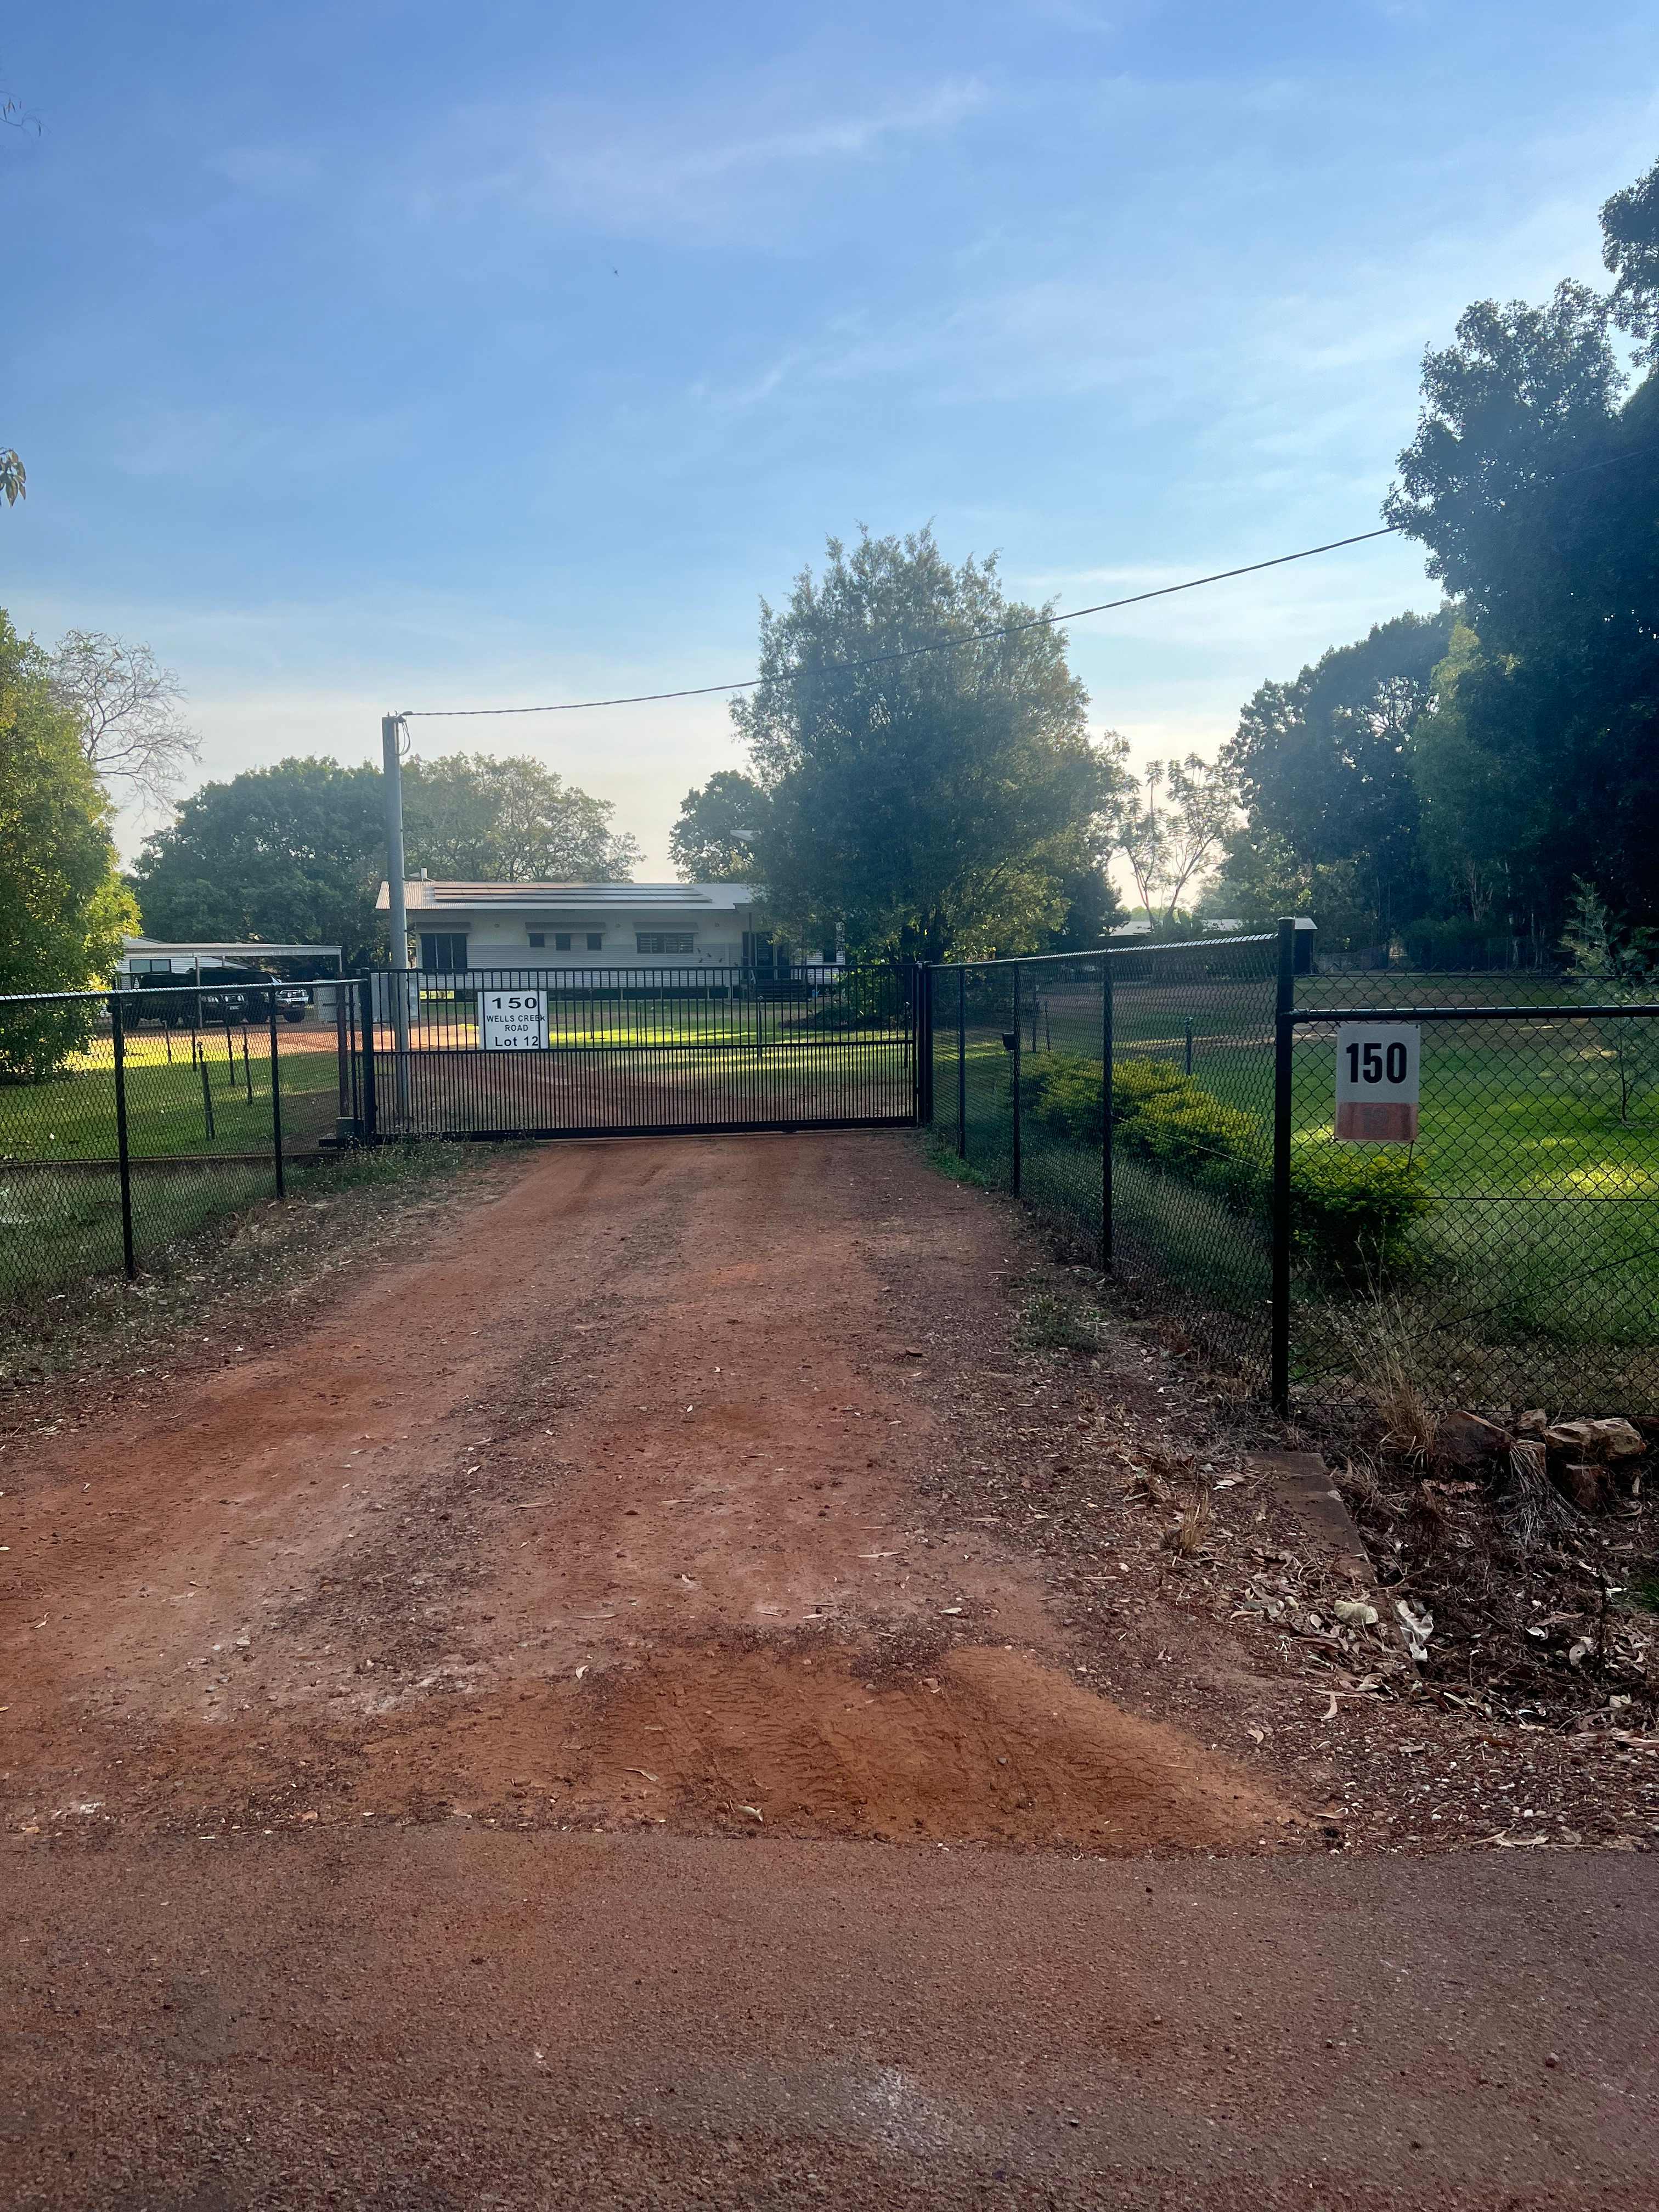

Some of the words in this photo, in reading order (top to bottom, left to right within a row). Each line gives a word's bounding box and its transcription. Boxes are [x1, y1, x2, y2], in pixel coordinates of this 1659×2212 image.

[492, 997, 537, 1009] 150
[495, 1036, 517, 1046] Lot
[523, 1036, 539, 1046] 12
[1346, 1042, 1407, 1084] 150
